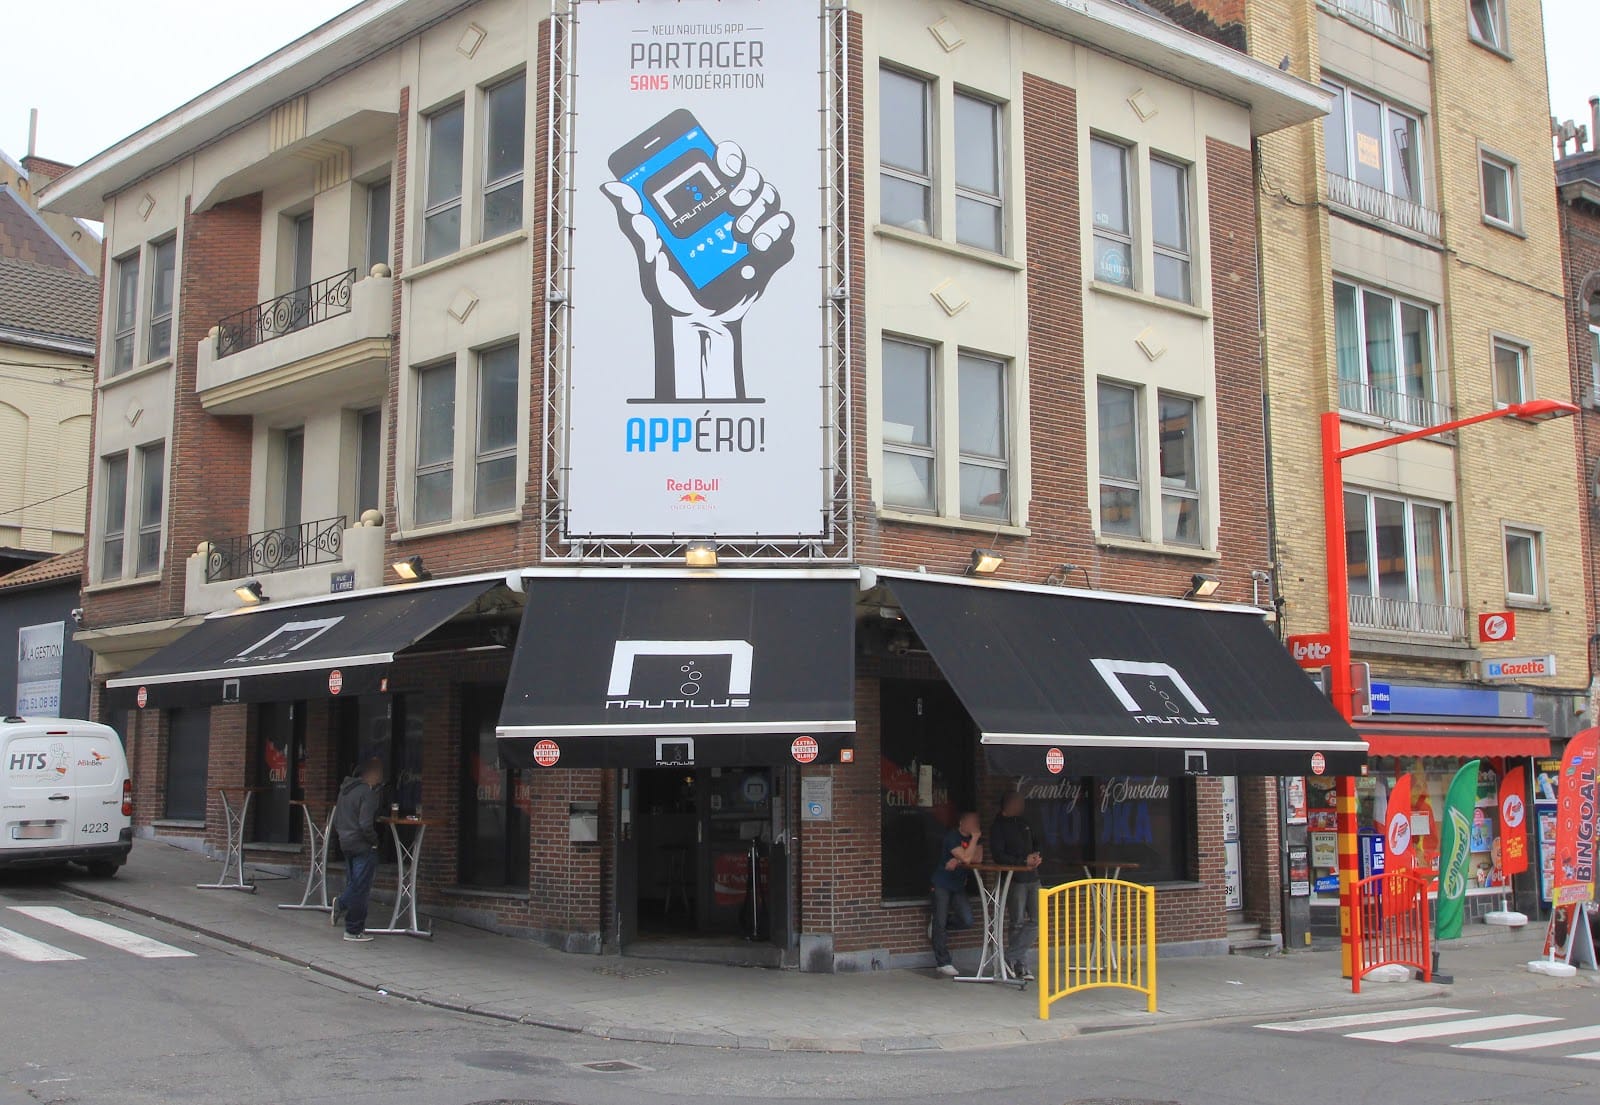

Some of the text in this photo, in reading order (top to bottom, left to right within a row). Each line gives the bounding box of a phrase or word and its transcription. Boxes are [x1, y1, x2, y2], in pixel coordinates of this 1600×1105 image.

[676, 24, 723, 35] NAUTILUS
[724, 24, 744, 34] APP
[630, 41, 764, 69] PARTAGER
[630, 71, 764, 91] SANS MODÉRATION
[673, 187, 727, 228] NAUTILUS
[626, 410, 766, 453] APPÉRO!
[666, 479, 719, 491] Red Bull
[35, 645, 61, 659] GESTION
[1501, 662, 1544, 675] Gazette
[605, 698, 751, 709] NAUTILUS
[1371, 692, 1390, 702] arettes
[1133, 715, 1219, 725] NAUTILUS
[9, 753, 47, 770] HTS
[1112, 776, 1169, 803] Sweden
[81, 822, 109, 834] 4223
[1576, 767, 1597, 882] BINGOAL
